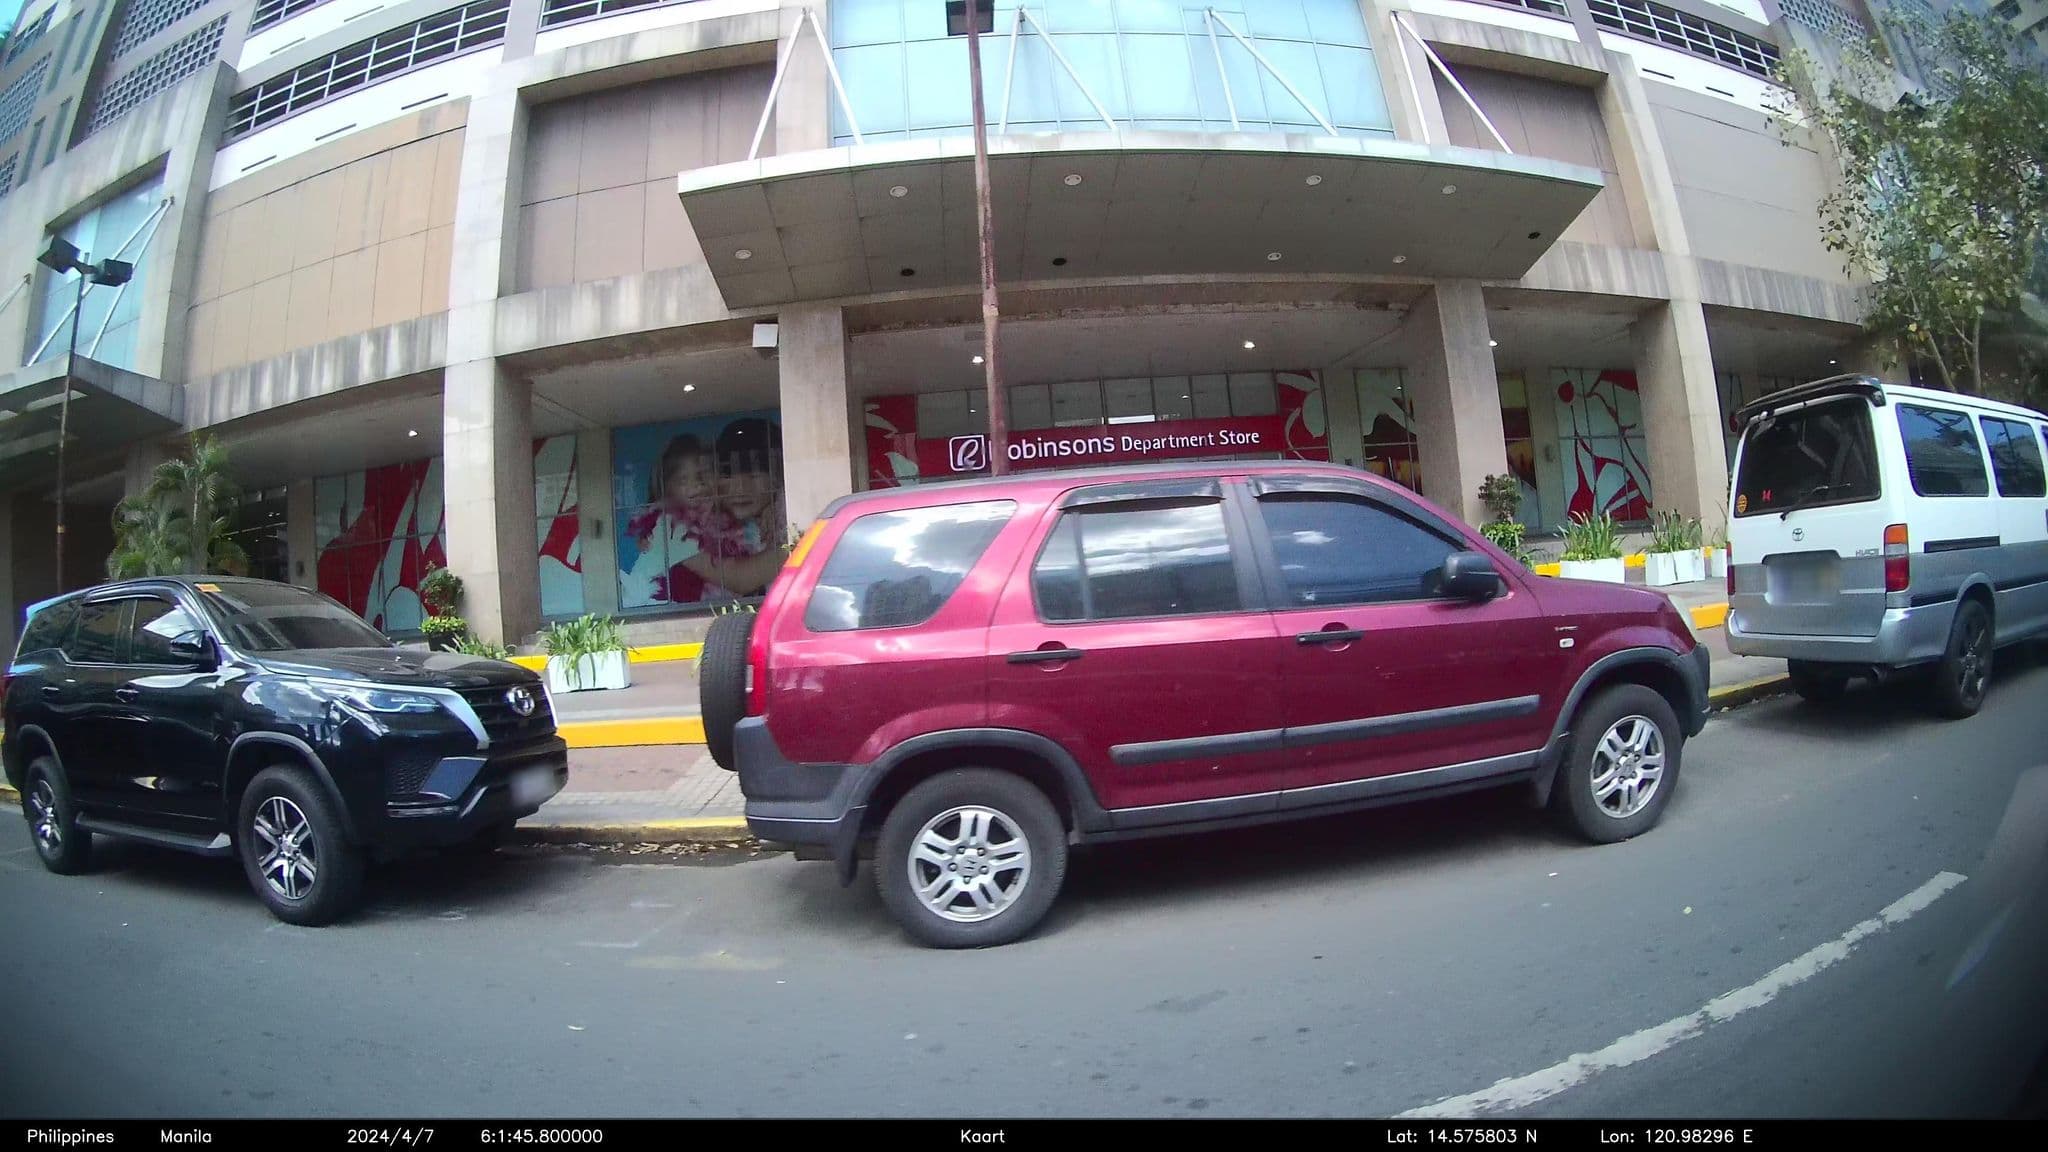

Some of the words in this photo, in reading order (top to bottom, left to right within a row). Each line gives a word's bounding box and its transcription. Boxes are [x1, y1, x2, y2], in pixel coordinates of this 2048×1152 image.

[988, 436, 1115, 462] obinsons
[1121, 432, 1216, 454] Department
[1219, 429, 1260, 445] Store
